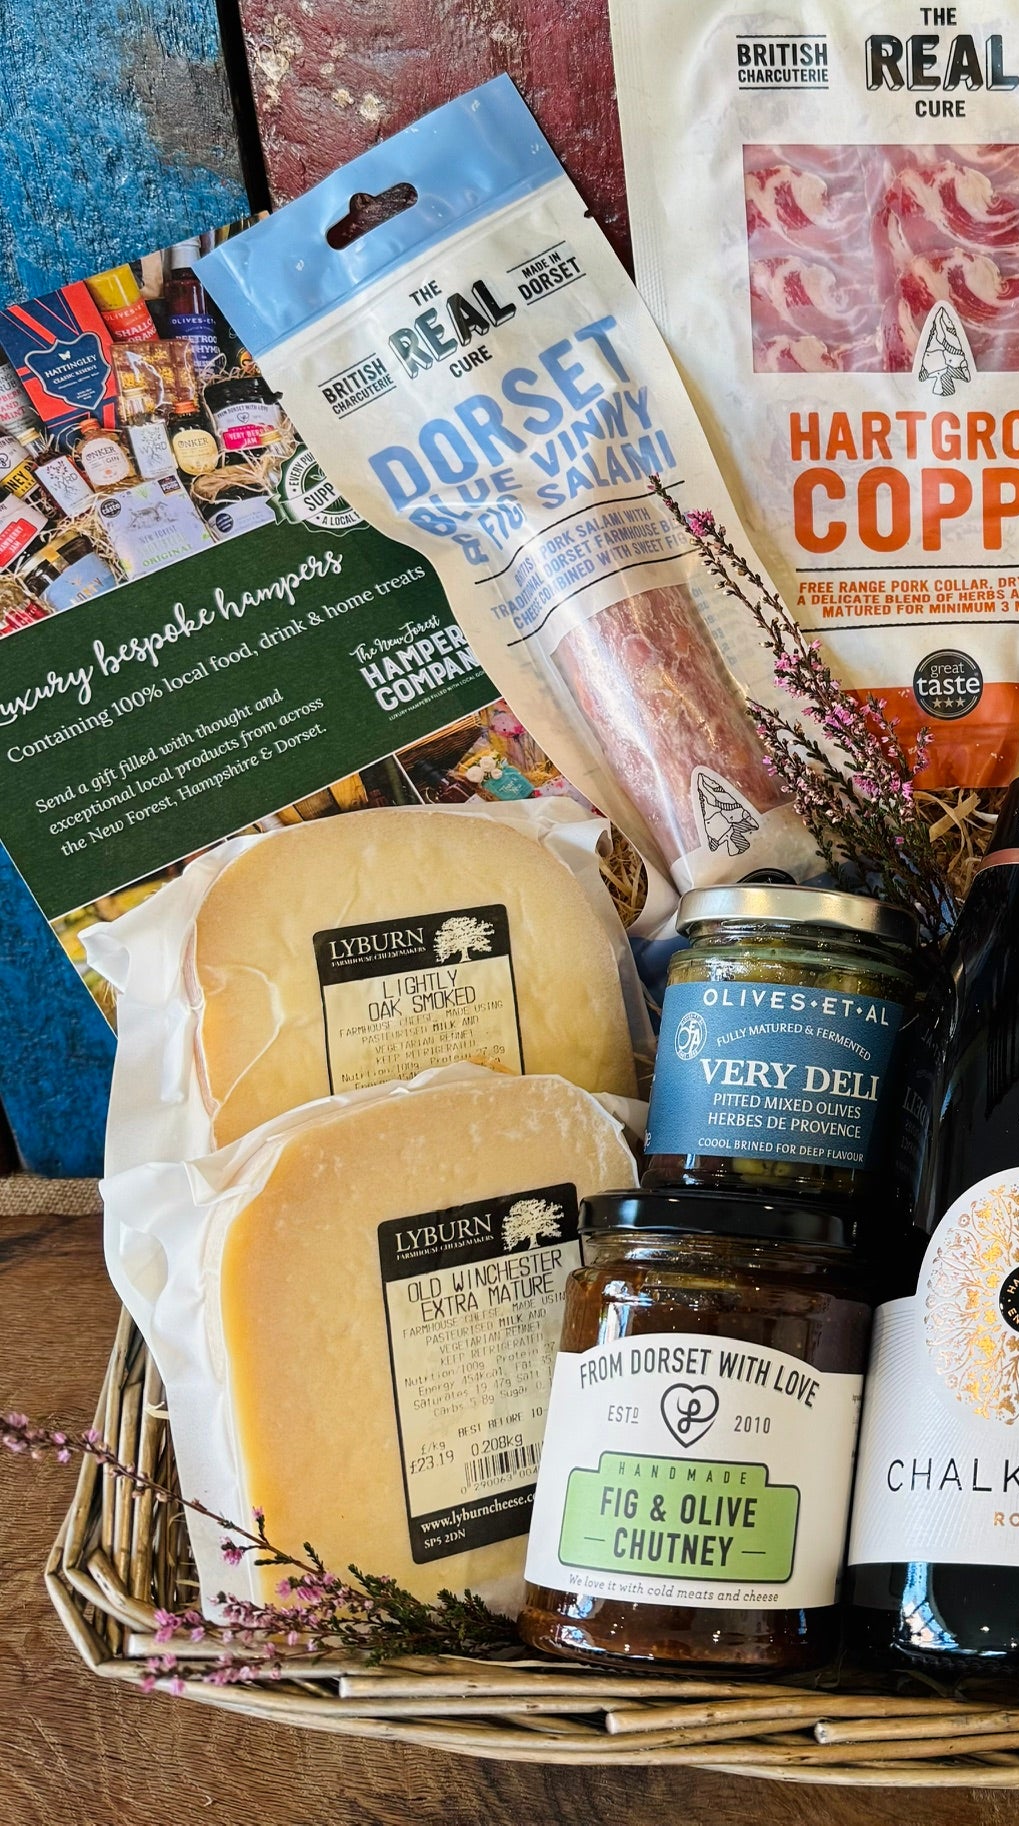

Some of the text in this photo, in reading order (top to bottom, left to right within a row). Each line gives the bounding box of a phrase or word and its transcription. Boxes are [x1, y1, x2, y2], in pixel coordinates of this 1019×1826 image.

[920, 7, 957, 27] THE
[737, 43, 829, 68] BRITISH
[865, 34, 1019, 92] REAL
[738, 67, 829, 84] CHARCUTERIE
[915, 100, 966, 118] CURE
[409, 280, 442, 306] THE
[518, 257, 582, 300] DORSET
[388, 279, 516, 379] REAL
[44, 354, 97, 379] HATTINGLEY
[321, 356, 387, 405] BRITISH
[449, 345, 493, 378] CURE
[368, 314, 632, 513] DORSET
[408, 386, 653, 537] BLUE VINNY
[93, 602, 216, 678] bespoke
[213, 550, 344, 621] hampers
[7, 565, 426, 763] Containing 100% local food, drink & home treats
[360, 624, 469, 689] HAMPER
[930, 661, 965, 679] great
[375, 647, 480, 711] COMPAN
[916, 676, 981, 697] taste
[35, 689, 284, 814] Send a gift filled with thought and
[49, 698, 325, 836] exceptional local products from across
[329, 928, 424, 960] LYBURN
[368, 986, 476, 1022] OAK SMOKED
[383, 969, 458, 999] LIGHTLY
[716, 1023, 871, 1062] FULLY MATURED & FERMENTED
[700, 1058, 879, 1101] VERY DELI
[708, 1112, 862, 1139] HERBES DE PROVENCE
[713, 1093, 862, 1119] PITTED MIXED OLIVES
[698, 1137, 864, 1163] COOOL BRINED FOR DEEP FLAVOUR
[395, 1213, 493, 1253] LYBURN
[407, 1250, 562, 1303] OLD WINCHESTER
[421, 1272, 555, 1323] EXTRA MATURE
[580, 1348, 820, 1410] FROM DORSET WITH LOVE
[410, 1450, 455, 1475] £23.19
[618, 1461, 748, 1485] HANDMADE
[600, 1486, 758, 1528] FIG & OLIVE
[613, 1527, 734, 1567] CHUTNEY
[568, 1574, 779, 1602] We love it with cold meats and cheese
